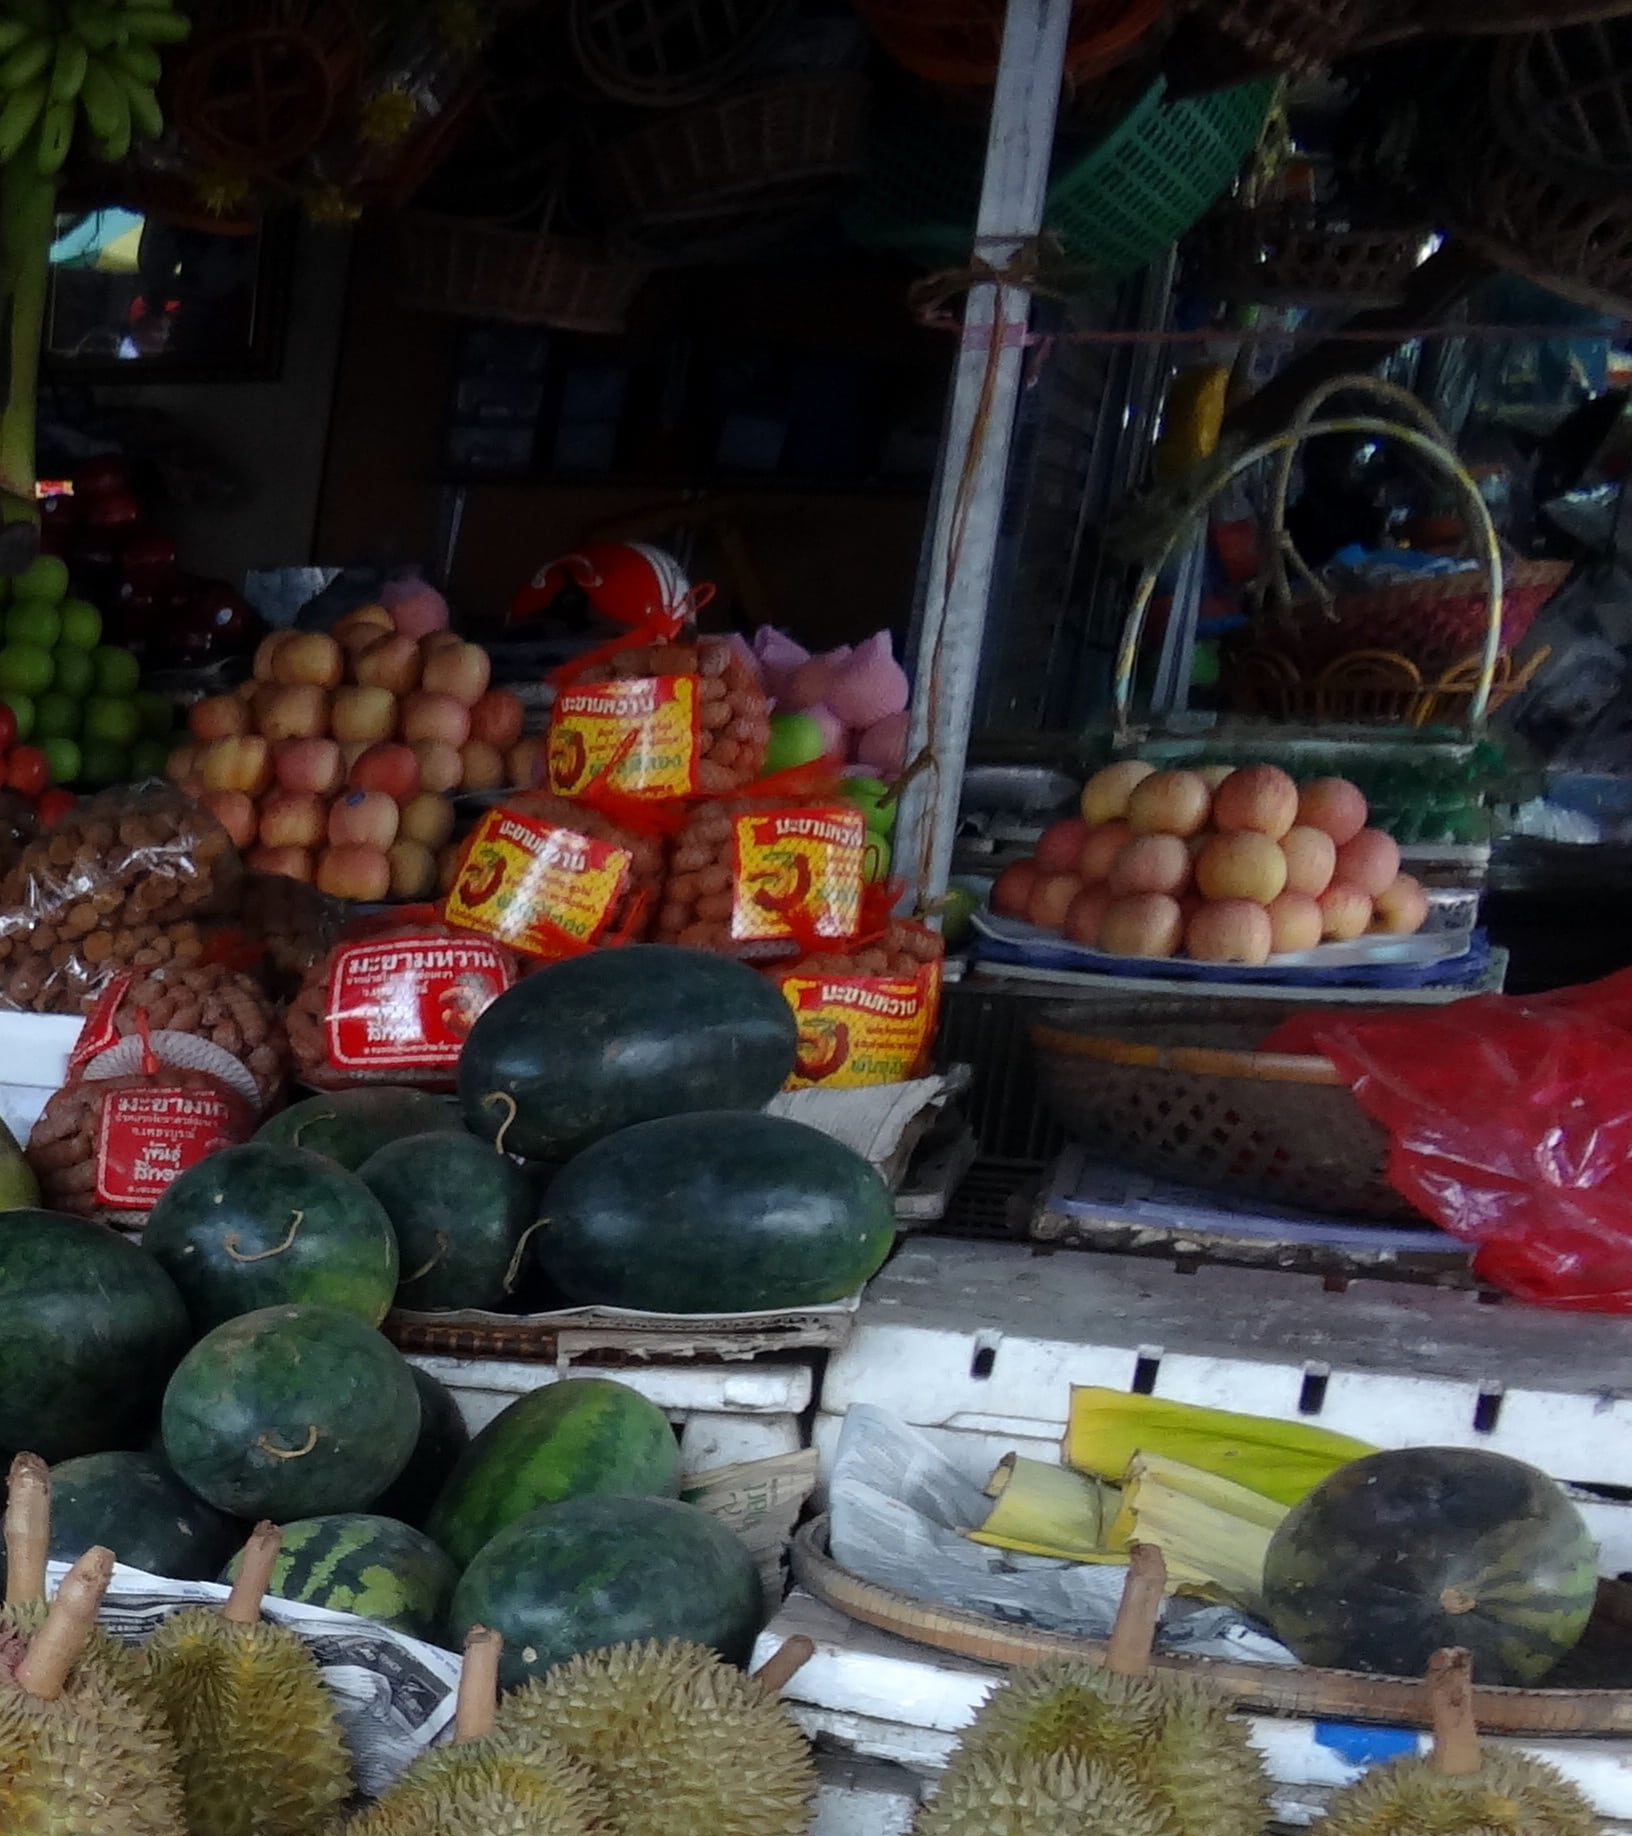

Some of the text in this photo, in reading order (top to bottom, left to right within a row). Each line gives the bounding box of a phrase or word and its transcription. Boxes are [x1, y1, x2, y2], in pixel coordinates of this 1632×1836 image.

[348, 949, 496, 974] มะขามหวาน
[822, 984, 916, 1016] มะขามหวาน
